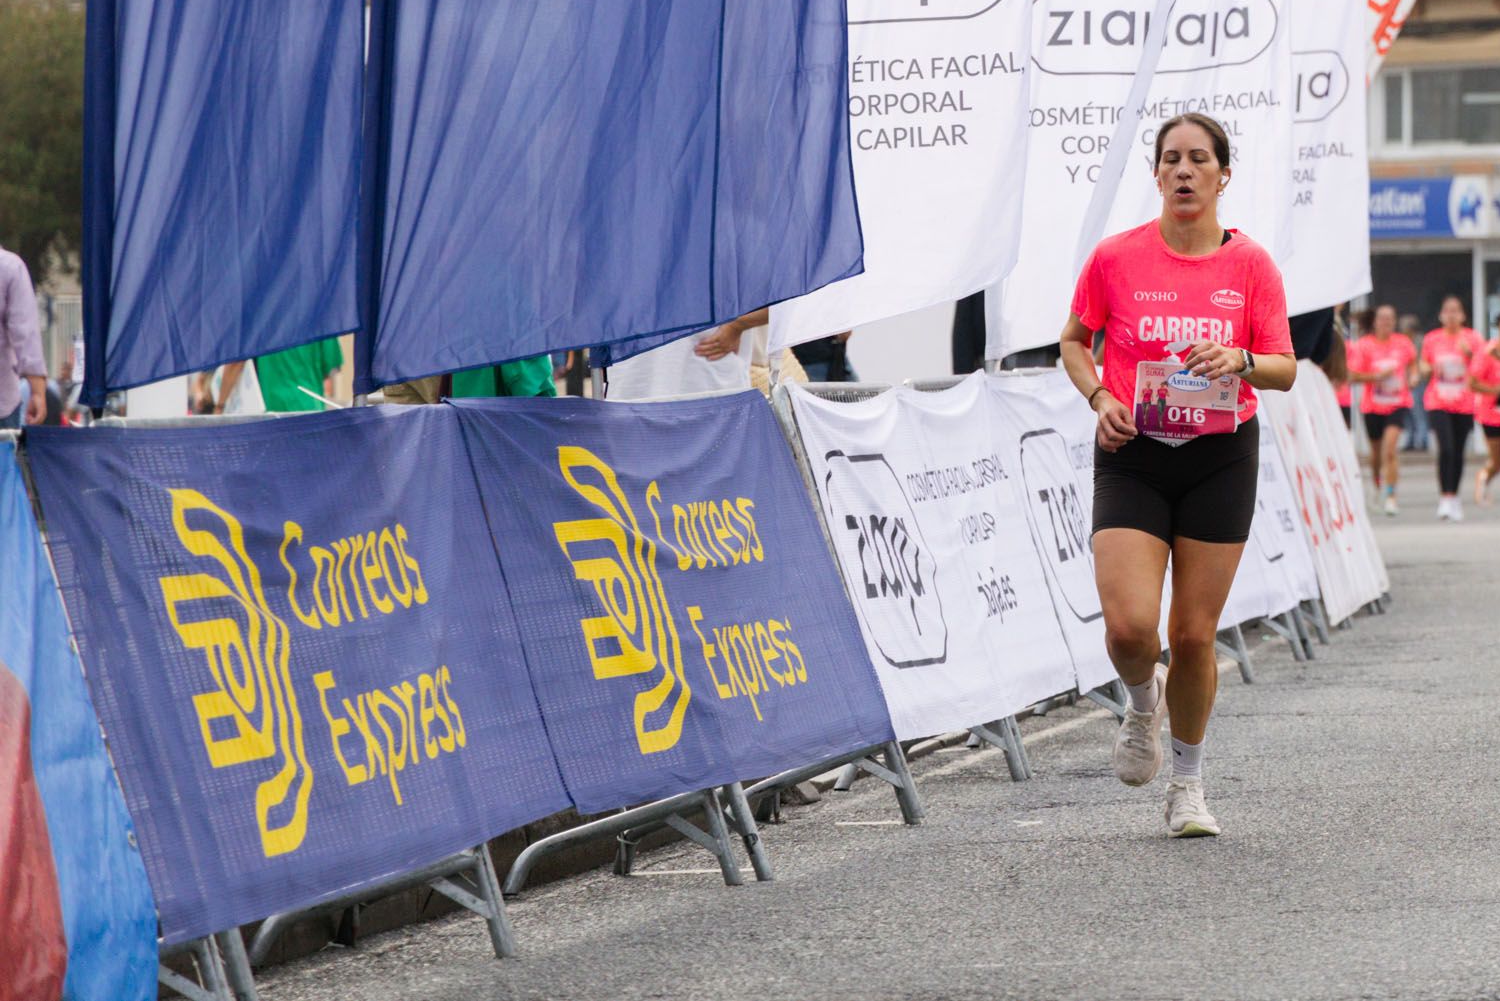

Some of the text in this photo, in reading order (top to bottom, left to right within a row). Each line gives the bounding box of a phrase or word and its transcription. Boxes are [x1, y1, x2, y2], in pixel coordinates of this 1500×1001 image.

[1047, 10, 1150, 47] zia
[852, 52, 1024, 83] ÉTICA FACIAL,
[849, 90, 972, 117] ORPORAL
[1142, 98, 1209, 120] MÉTICA
[1213, 90, 1280, 111] FACIAL,
[856, 124, 968, 150] CAPILAR
[1134, 291, 1177, 301] OYSHO
[1138, 316, 1234, 345] CARRERA
[1171, 376, 1208, 387] ASTURIANA
[1168, 406, 1206, 424] 016
[646, 480, 764, 571] Correos
[279, 520, 428, 630] Correos
[686, 605, 807, 721] Express
[312, 665, 466, 806] Express
